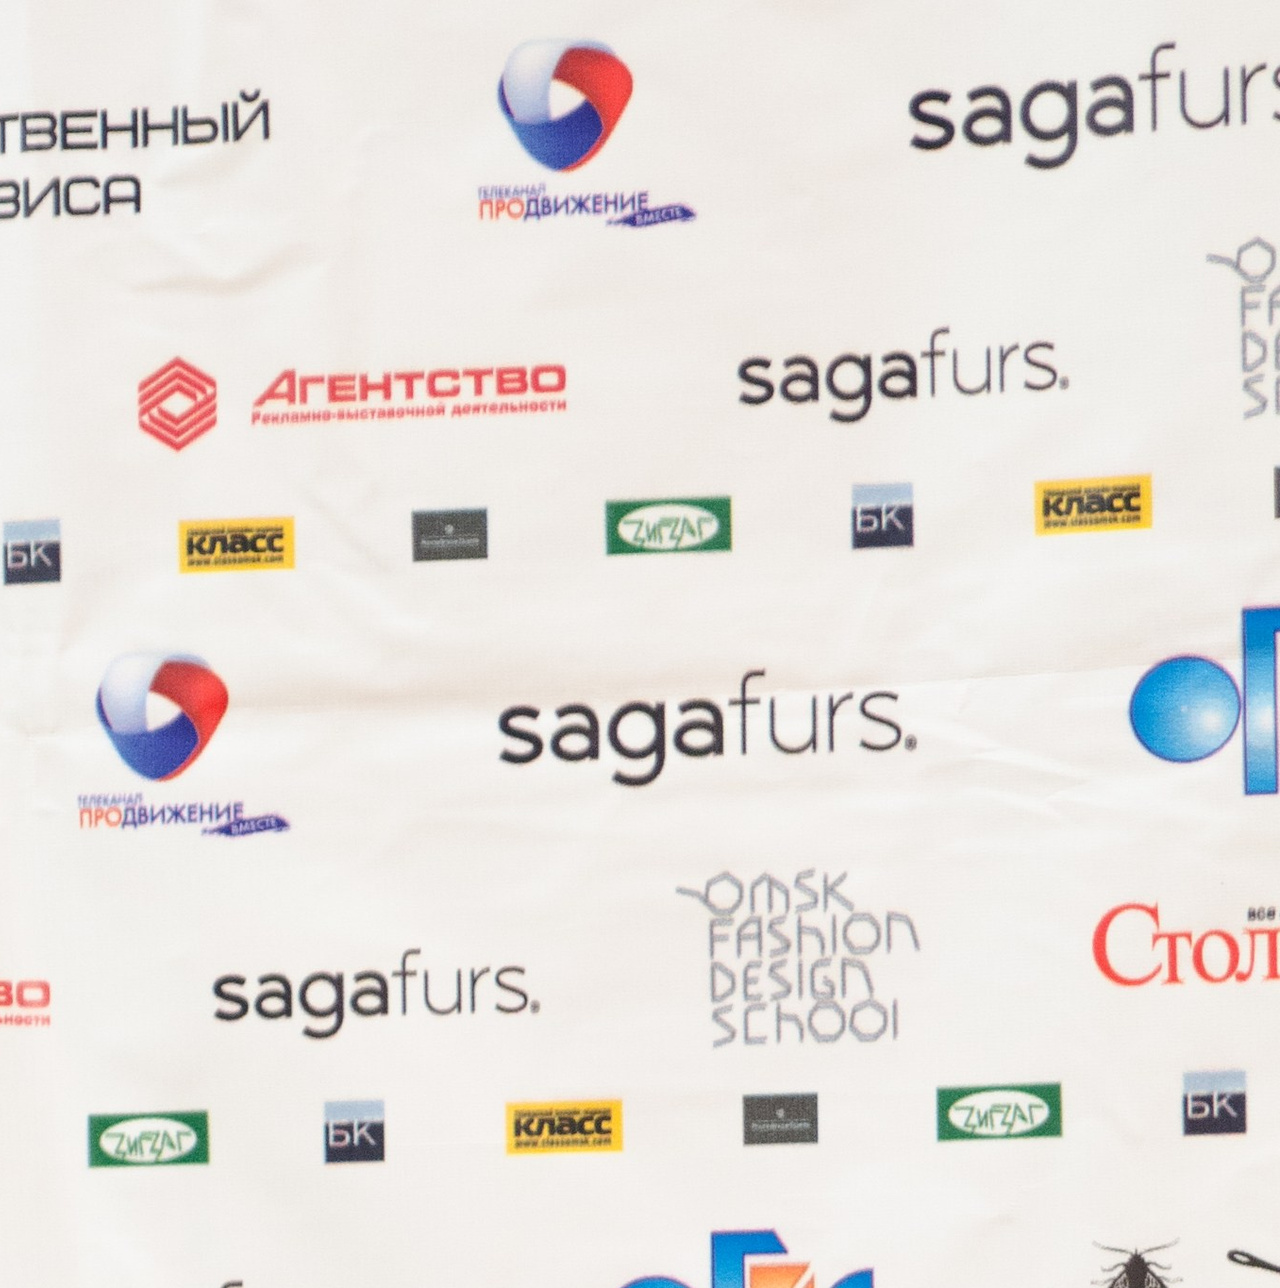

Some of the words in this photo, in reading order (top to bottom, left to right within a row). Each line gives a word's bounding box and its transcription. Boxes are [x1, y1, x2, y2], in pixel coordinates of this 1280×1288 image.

[855, 504, 904, 532] БК
[6, 540, 53, 568] БК
[1187, 1091, 1238, 1120] БК
[328, 1120, 377, 1148] БК
